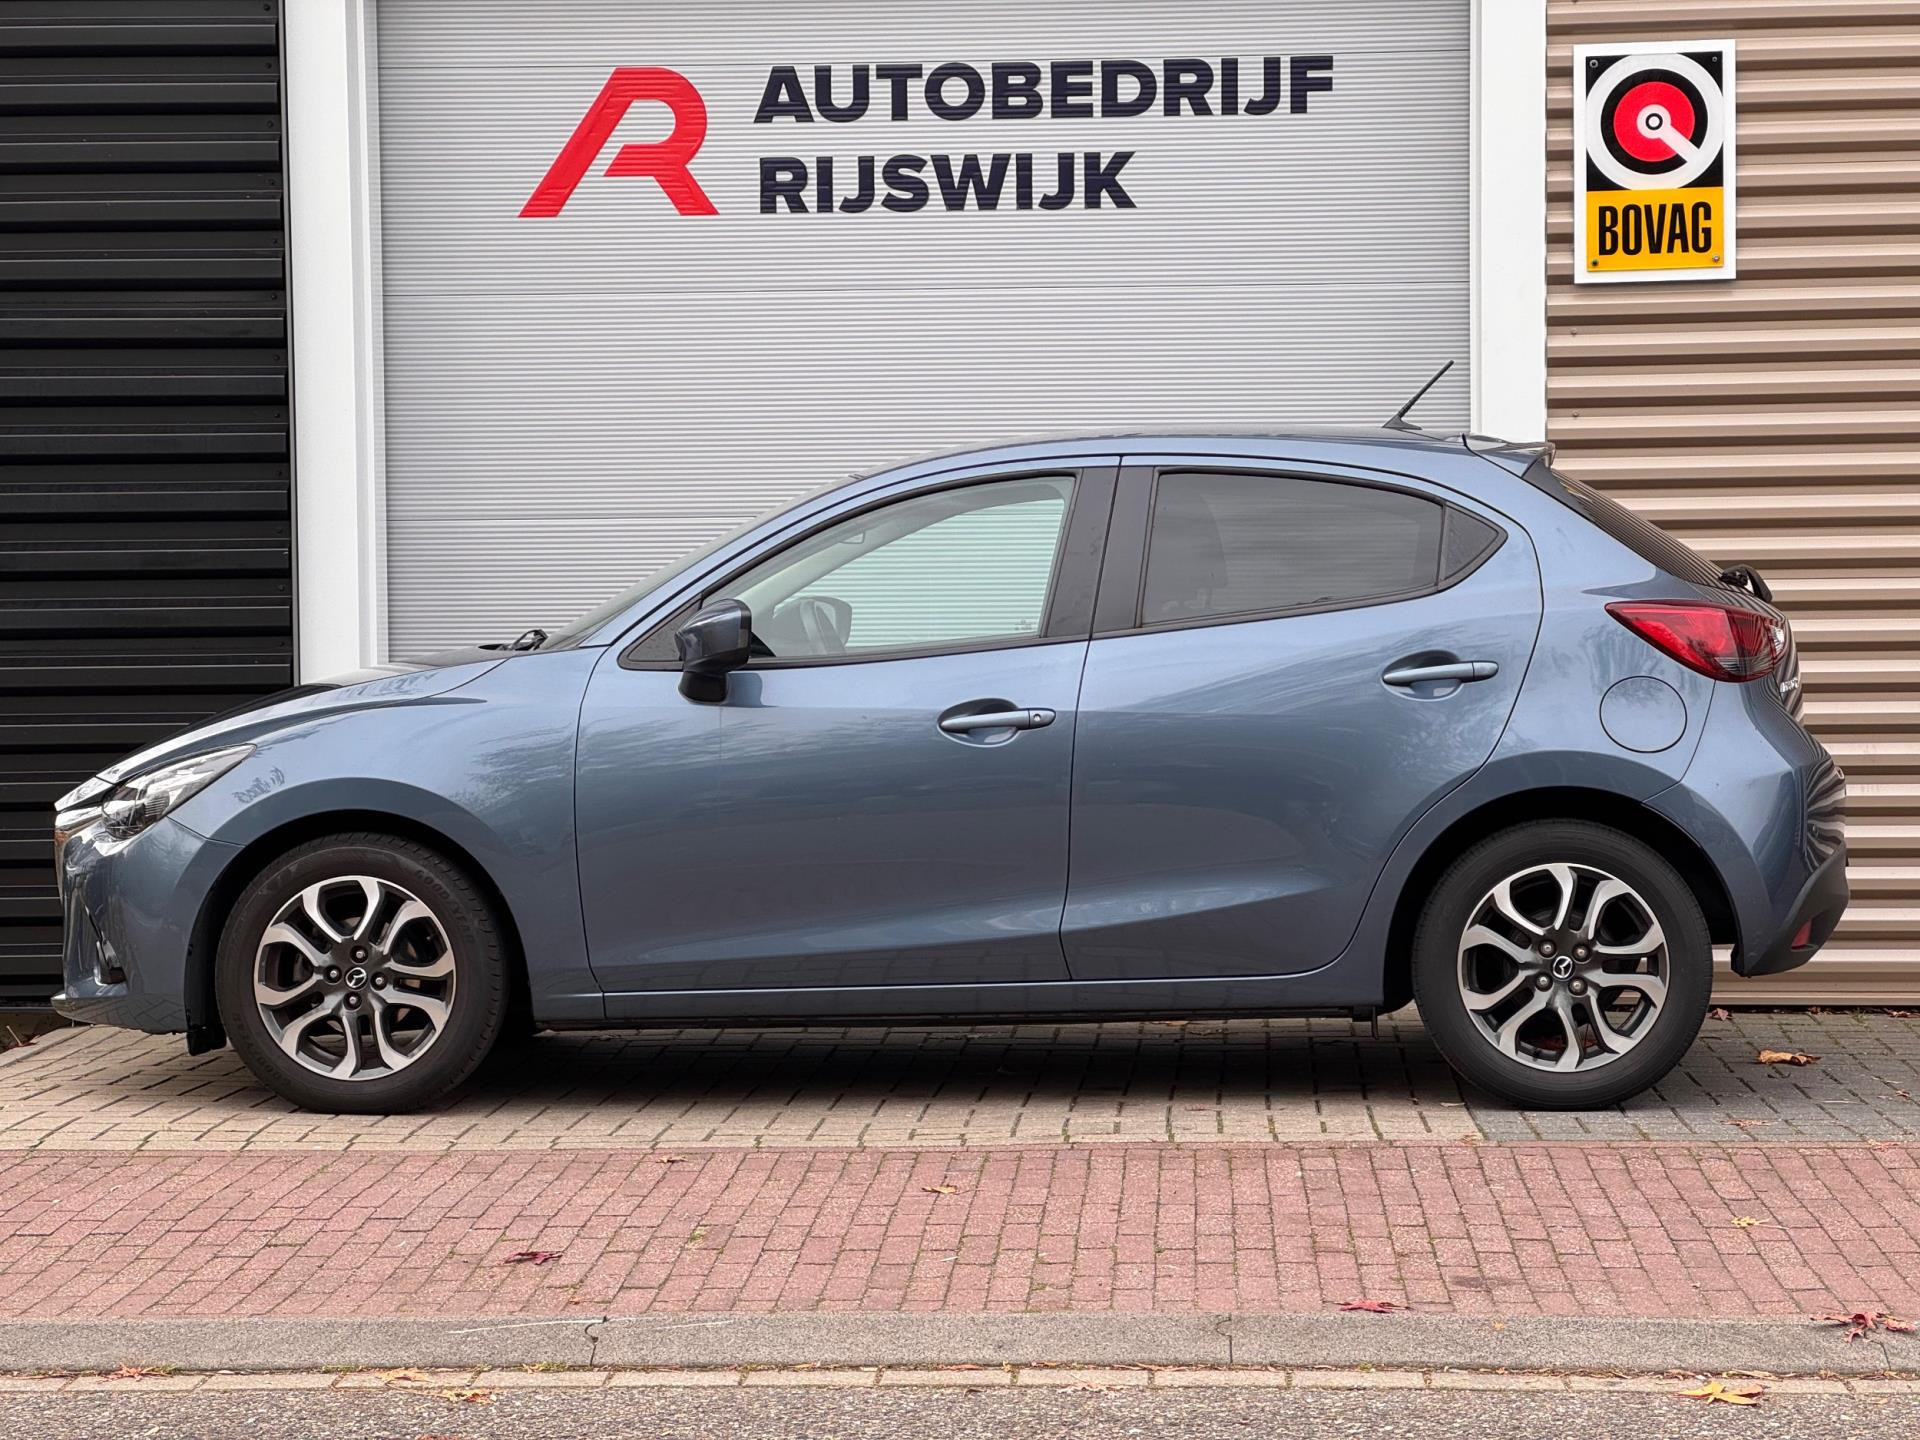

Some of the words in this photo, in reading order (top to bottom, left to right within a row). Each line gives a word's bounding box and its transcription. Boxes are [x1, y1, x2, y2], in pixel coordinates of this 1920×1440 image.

[753, 55, 1334, 124] AUTOBEDRIJF
[759, 151, 1136, 214] RIJSWIJK
[1598, 201, 1712, 256] BOVAG
